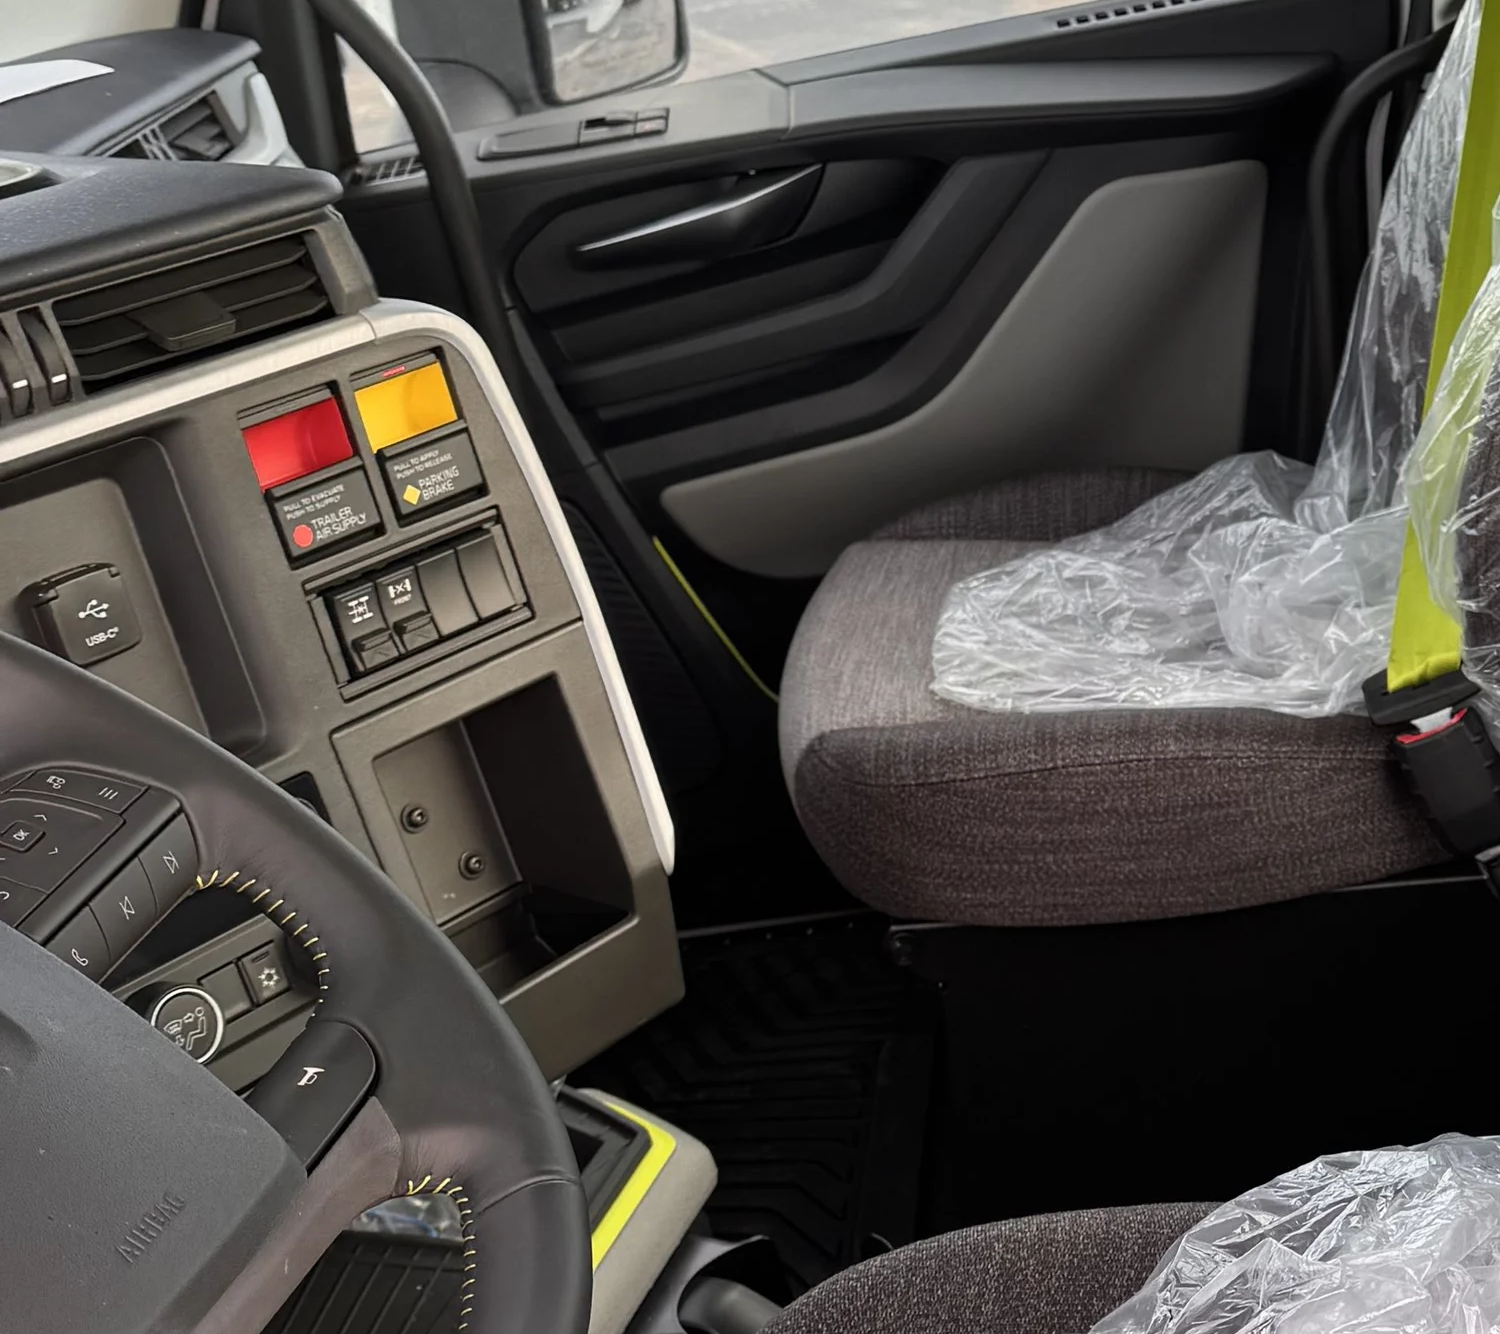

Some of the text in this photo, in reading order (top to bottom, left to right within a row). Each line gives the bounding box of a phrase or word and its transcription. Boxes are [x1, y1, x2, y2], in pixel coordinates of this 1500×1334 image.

[418, 466, 460, 489] PARKING
[422, 479, 456, 501] BRAKE
[311, 506, 353, 530] TRAILER
[316, 513, 368, 542] AIR SUPPLY
[13, 828, 30, 841] OK
[115, 1191, 185, 1266] AIRBAG
